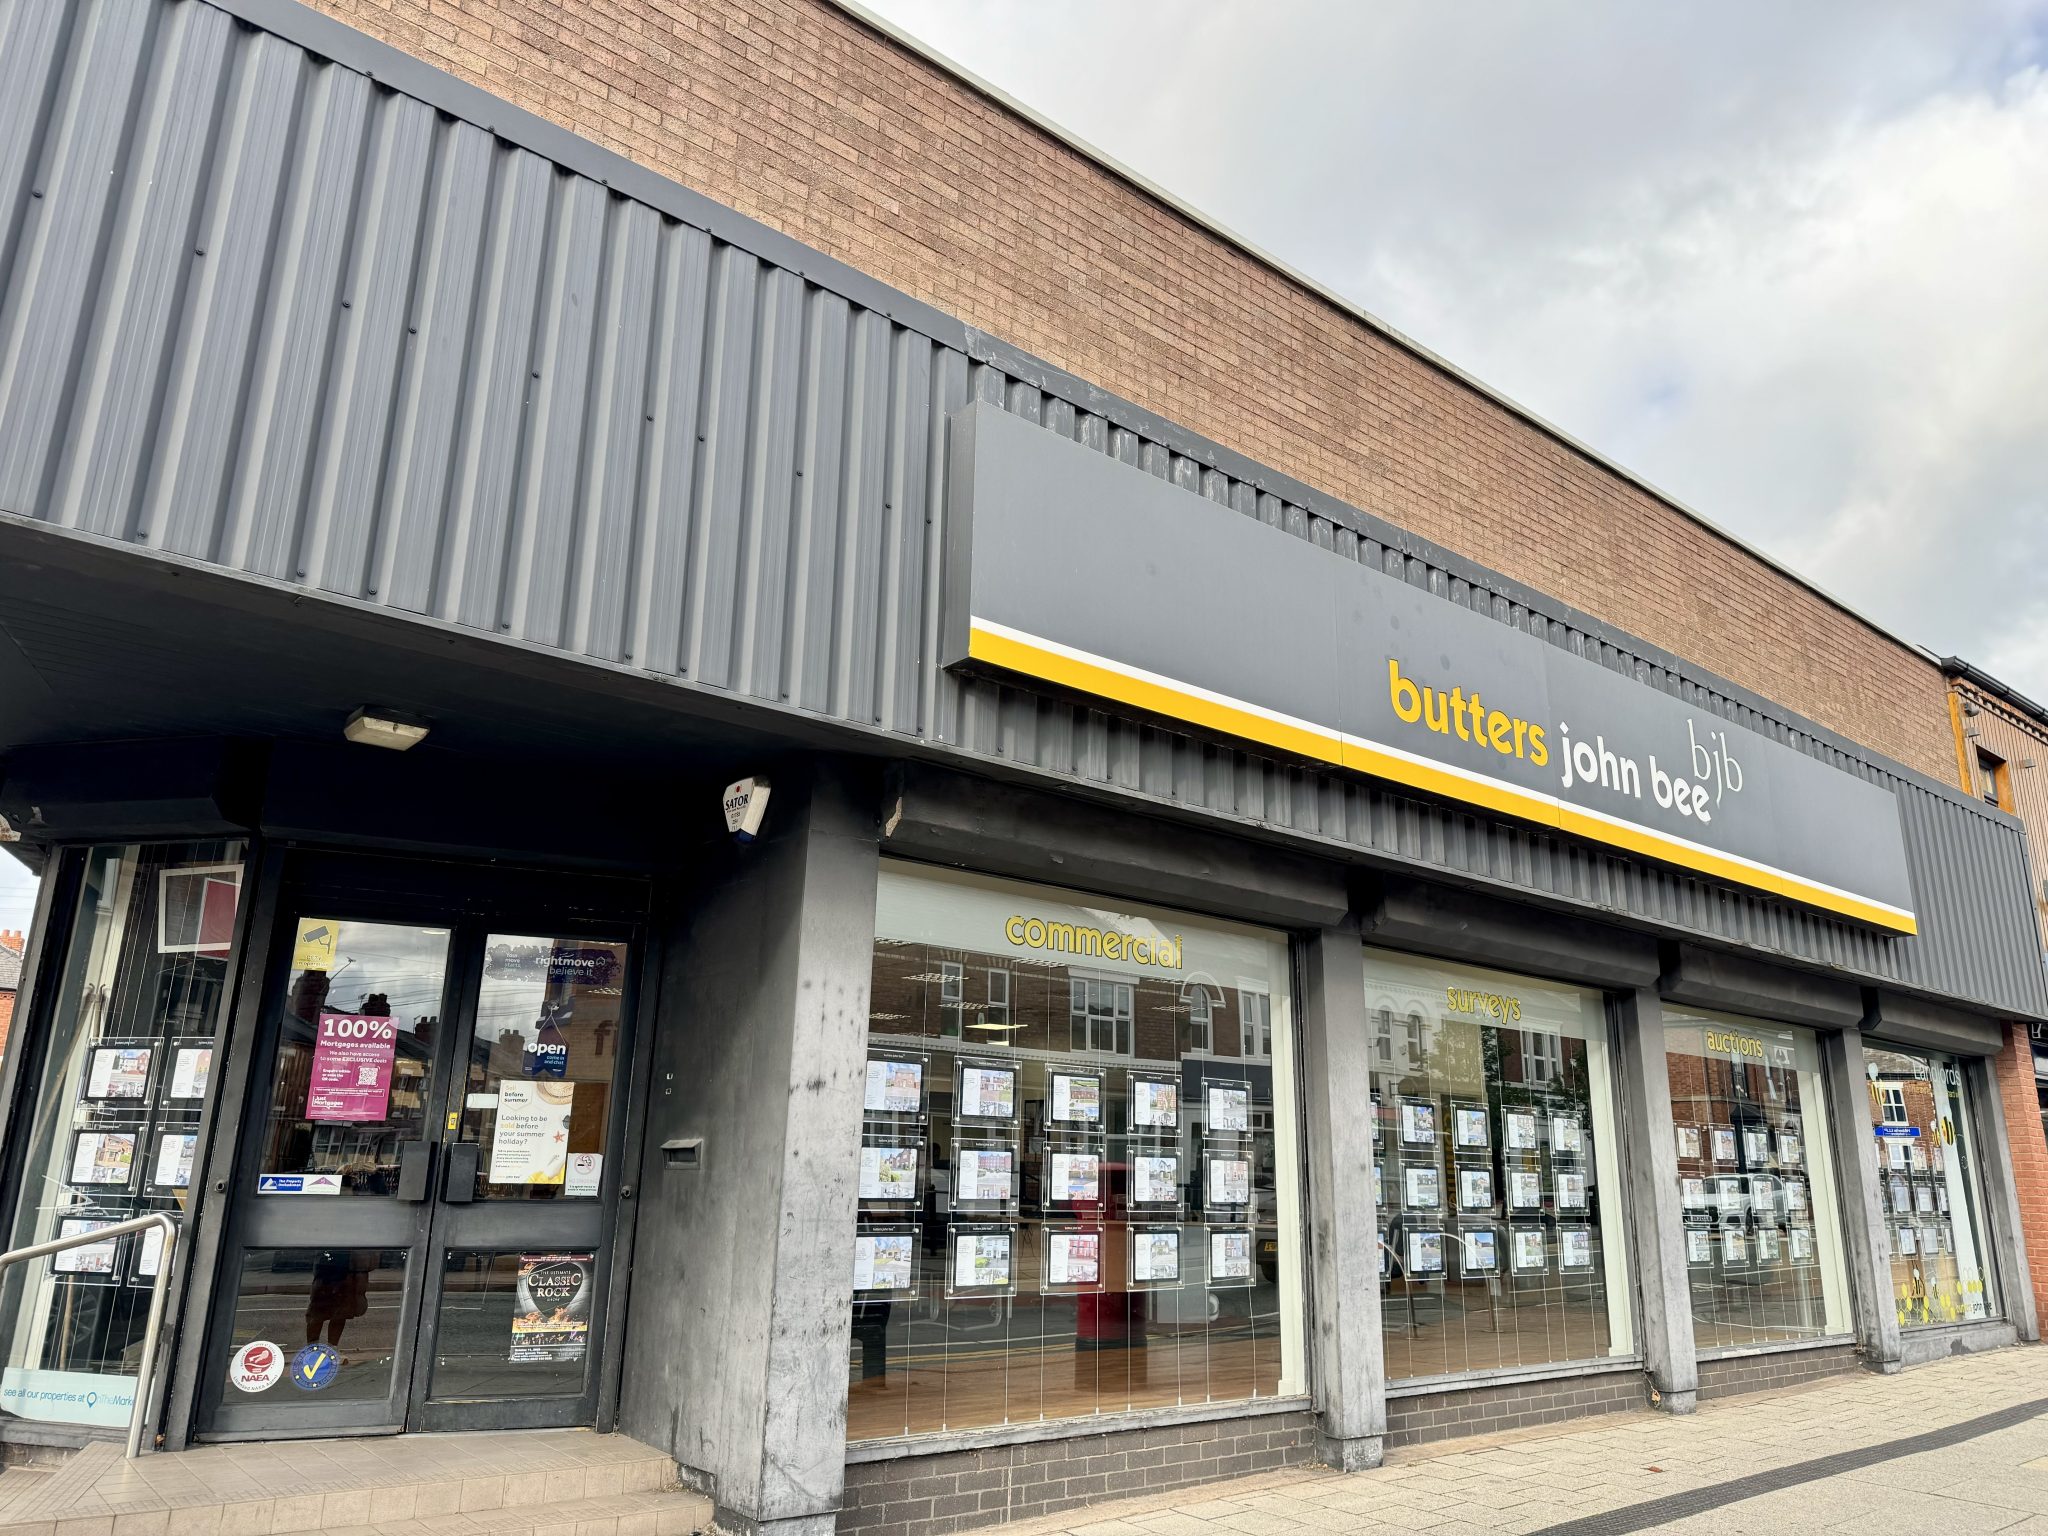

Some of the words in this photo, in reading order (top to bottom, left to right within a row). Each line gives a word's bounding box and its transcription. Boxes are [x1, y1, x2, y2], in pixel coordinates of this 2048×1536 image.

[1389, 659, 1549, 767] butters
[1559, 721, 1642, 798] john
[1649, 755, 1713, 822] bee
[1687, 719, 1743, 808] bjb
[725, 794, 749, 811] SATOR
[1005, 914, 1184, 970] commercial
[535, 956, 595, 967] rightmove
[549, 967, 584, 976] believe
[586, 968, 593, 976] it
[1446, 986, 1522, 1026] surveys
[323, 1018, 392, 1039] 100%
[320, 1040, 359, 1049] Mortgages
[527, 1042, 566, 1056] open
[1707, 1028, 1764, 1058] auctions
[1913, 1059, 1961, 1087] Landlords
[528, 1273, 581, 1286] CLASSIC
[536, 1287, 570, 1297] ROCK
[240, 1374, 270, 1382] NAEA
[4, 1388, 16, 1397] see
[17, 1388, 26, 1397] all
[27, 1391, 39, 1399] our
[40, 1391, 77, 1402] properties
[78, 1393, 85, 1402] at
